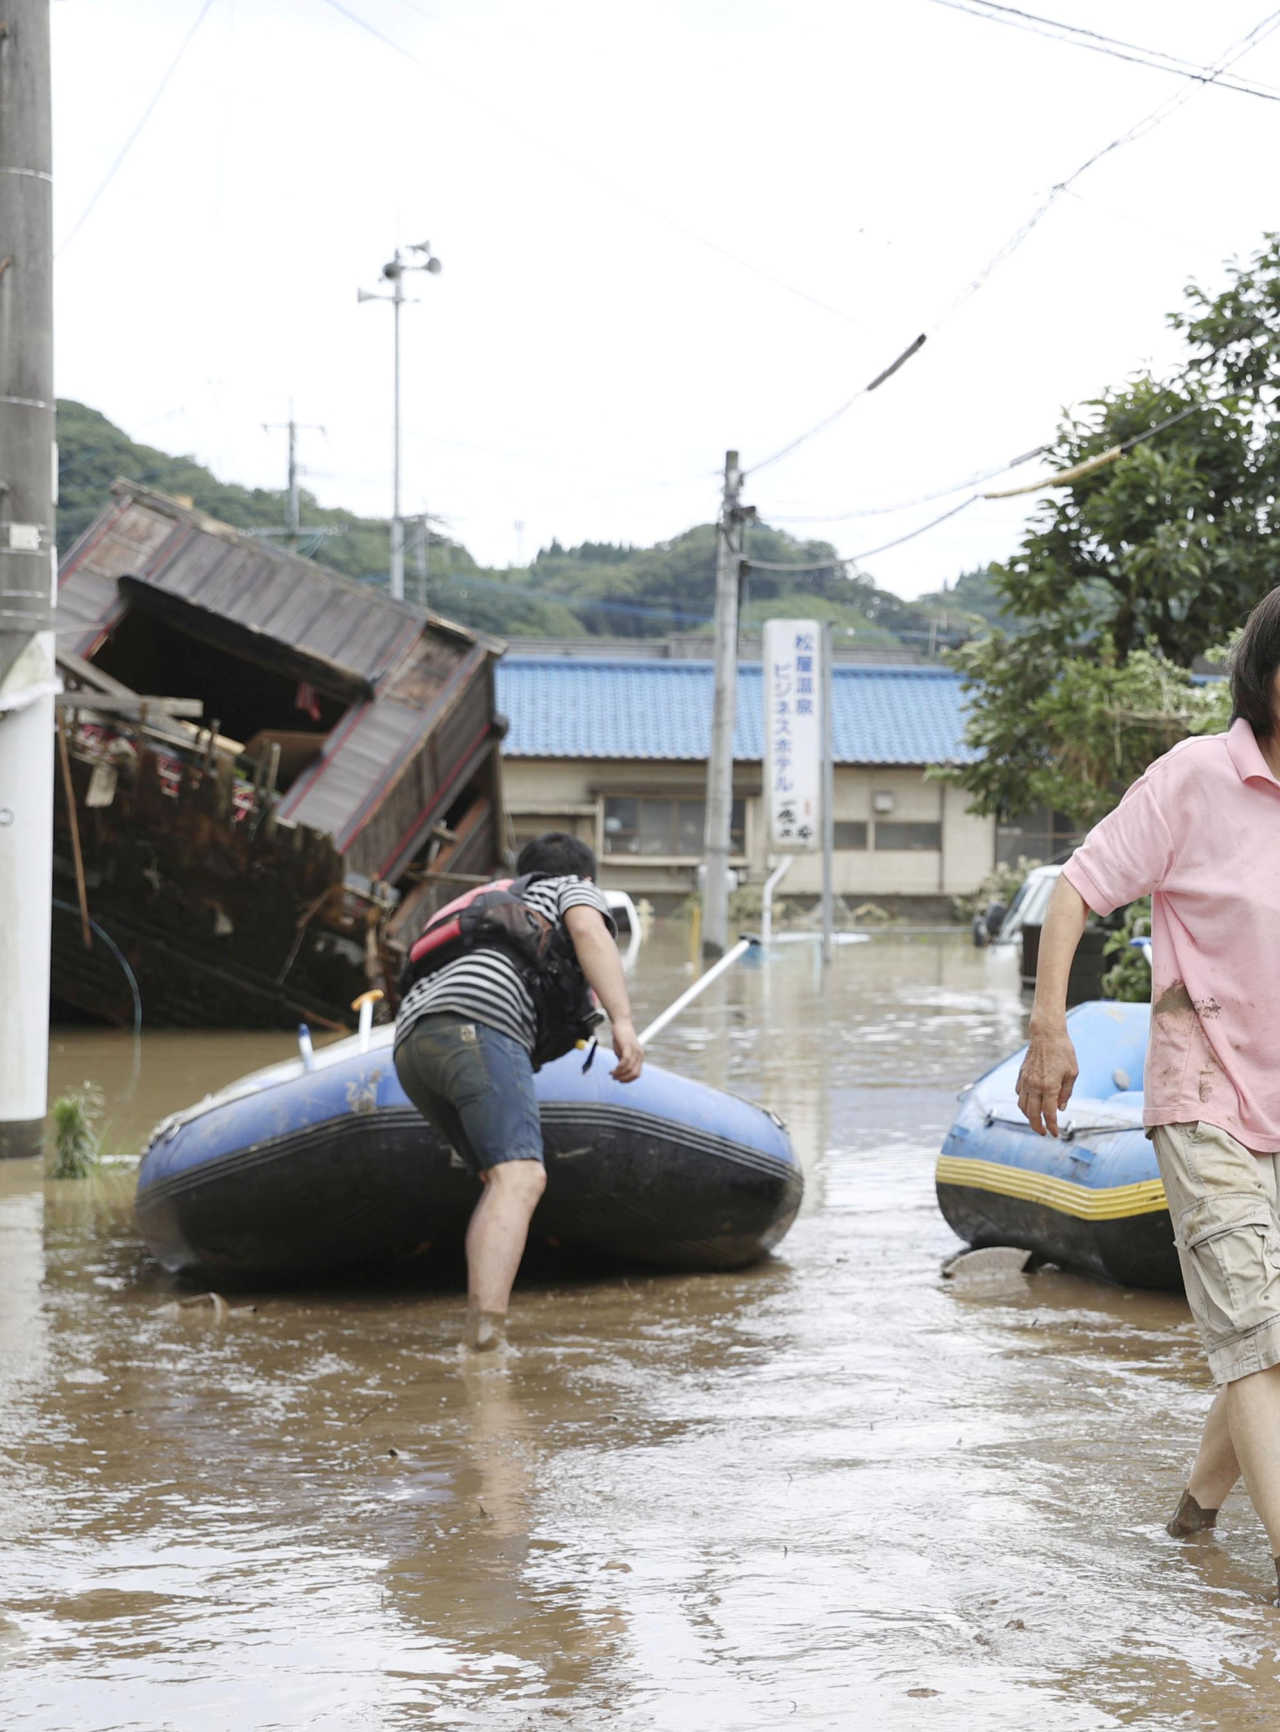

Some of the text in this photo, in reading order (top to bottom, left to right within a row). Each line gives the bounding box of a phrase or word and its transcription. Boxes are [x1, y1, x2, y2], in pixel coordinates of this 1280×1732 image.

[774, 663, 793, 792] ビジネスホテル
